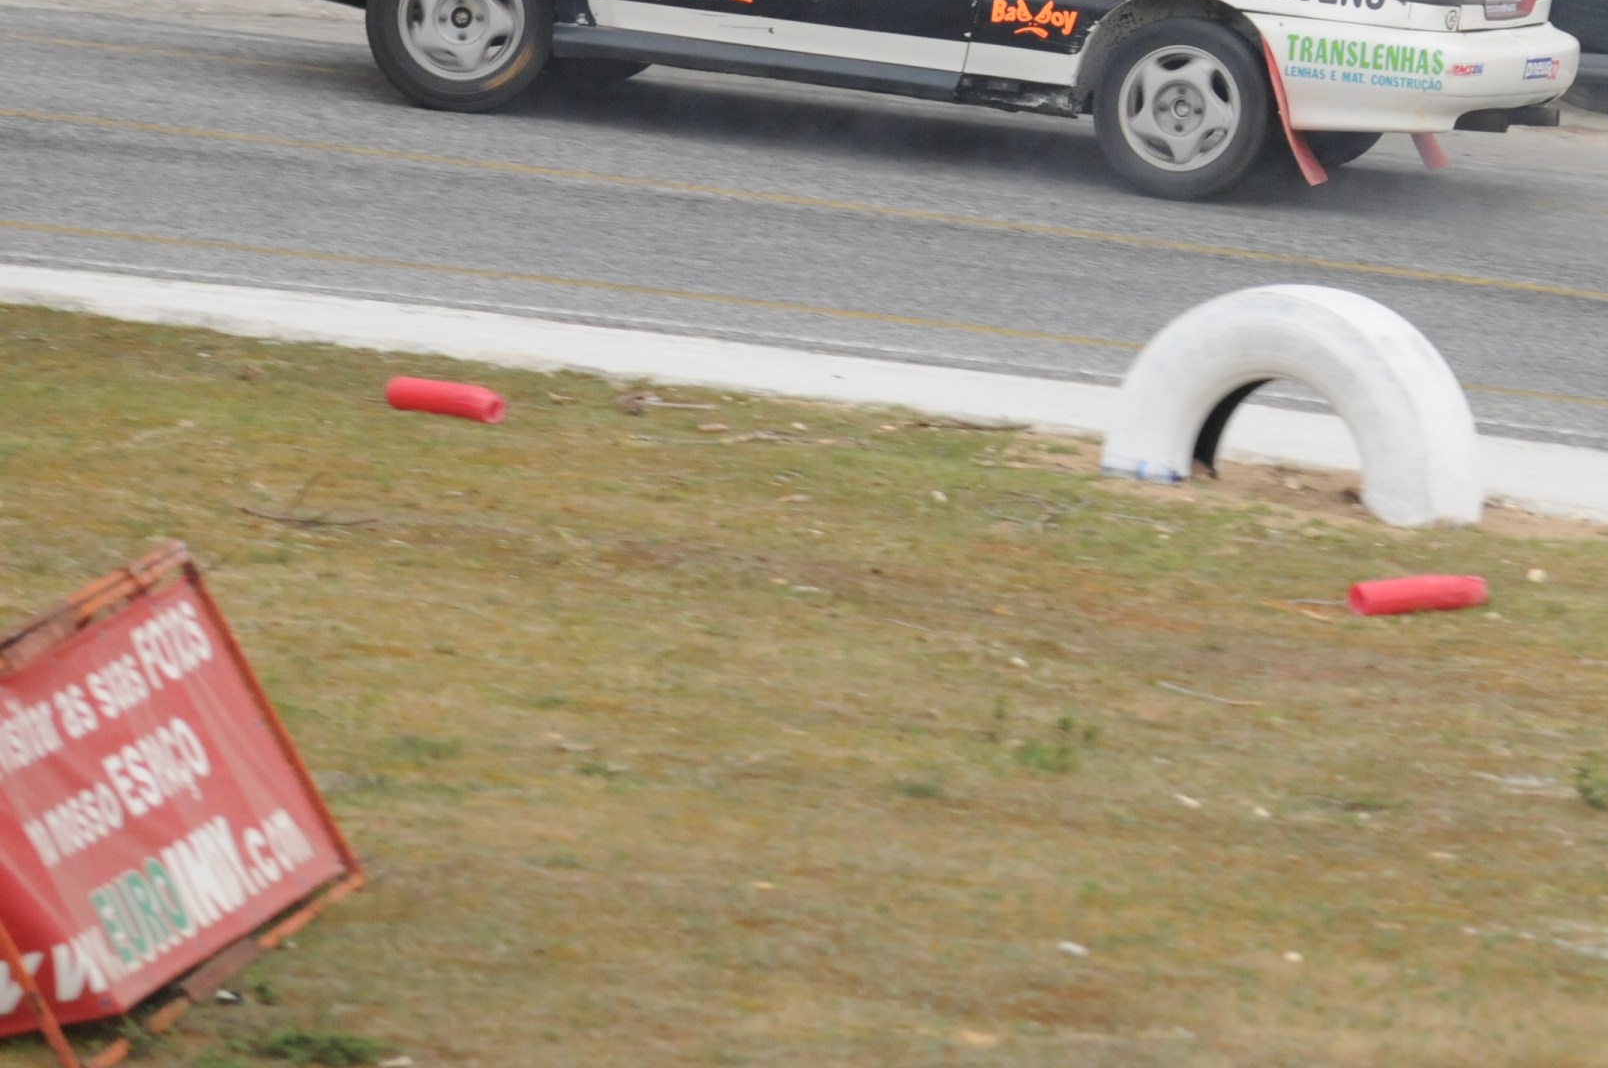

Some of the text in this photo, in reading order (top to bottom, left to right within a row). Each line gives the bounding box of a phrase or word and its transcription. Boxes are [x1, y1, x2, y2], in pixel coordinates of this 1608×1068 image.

[1287, 33, 1444, 76] TRANSLENHAS
[1284, 65, 1443, 93] LENHAS E MAT. CONSTRUÇÃO
